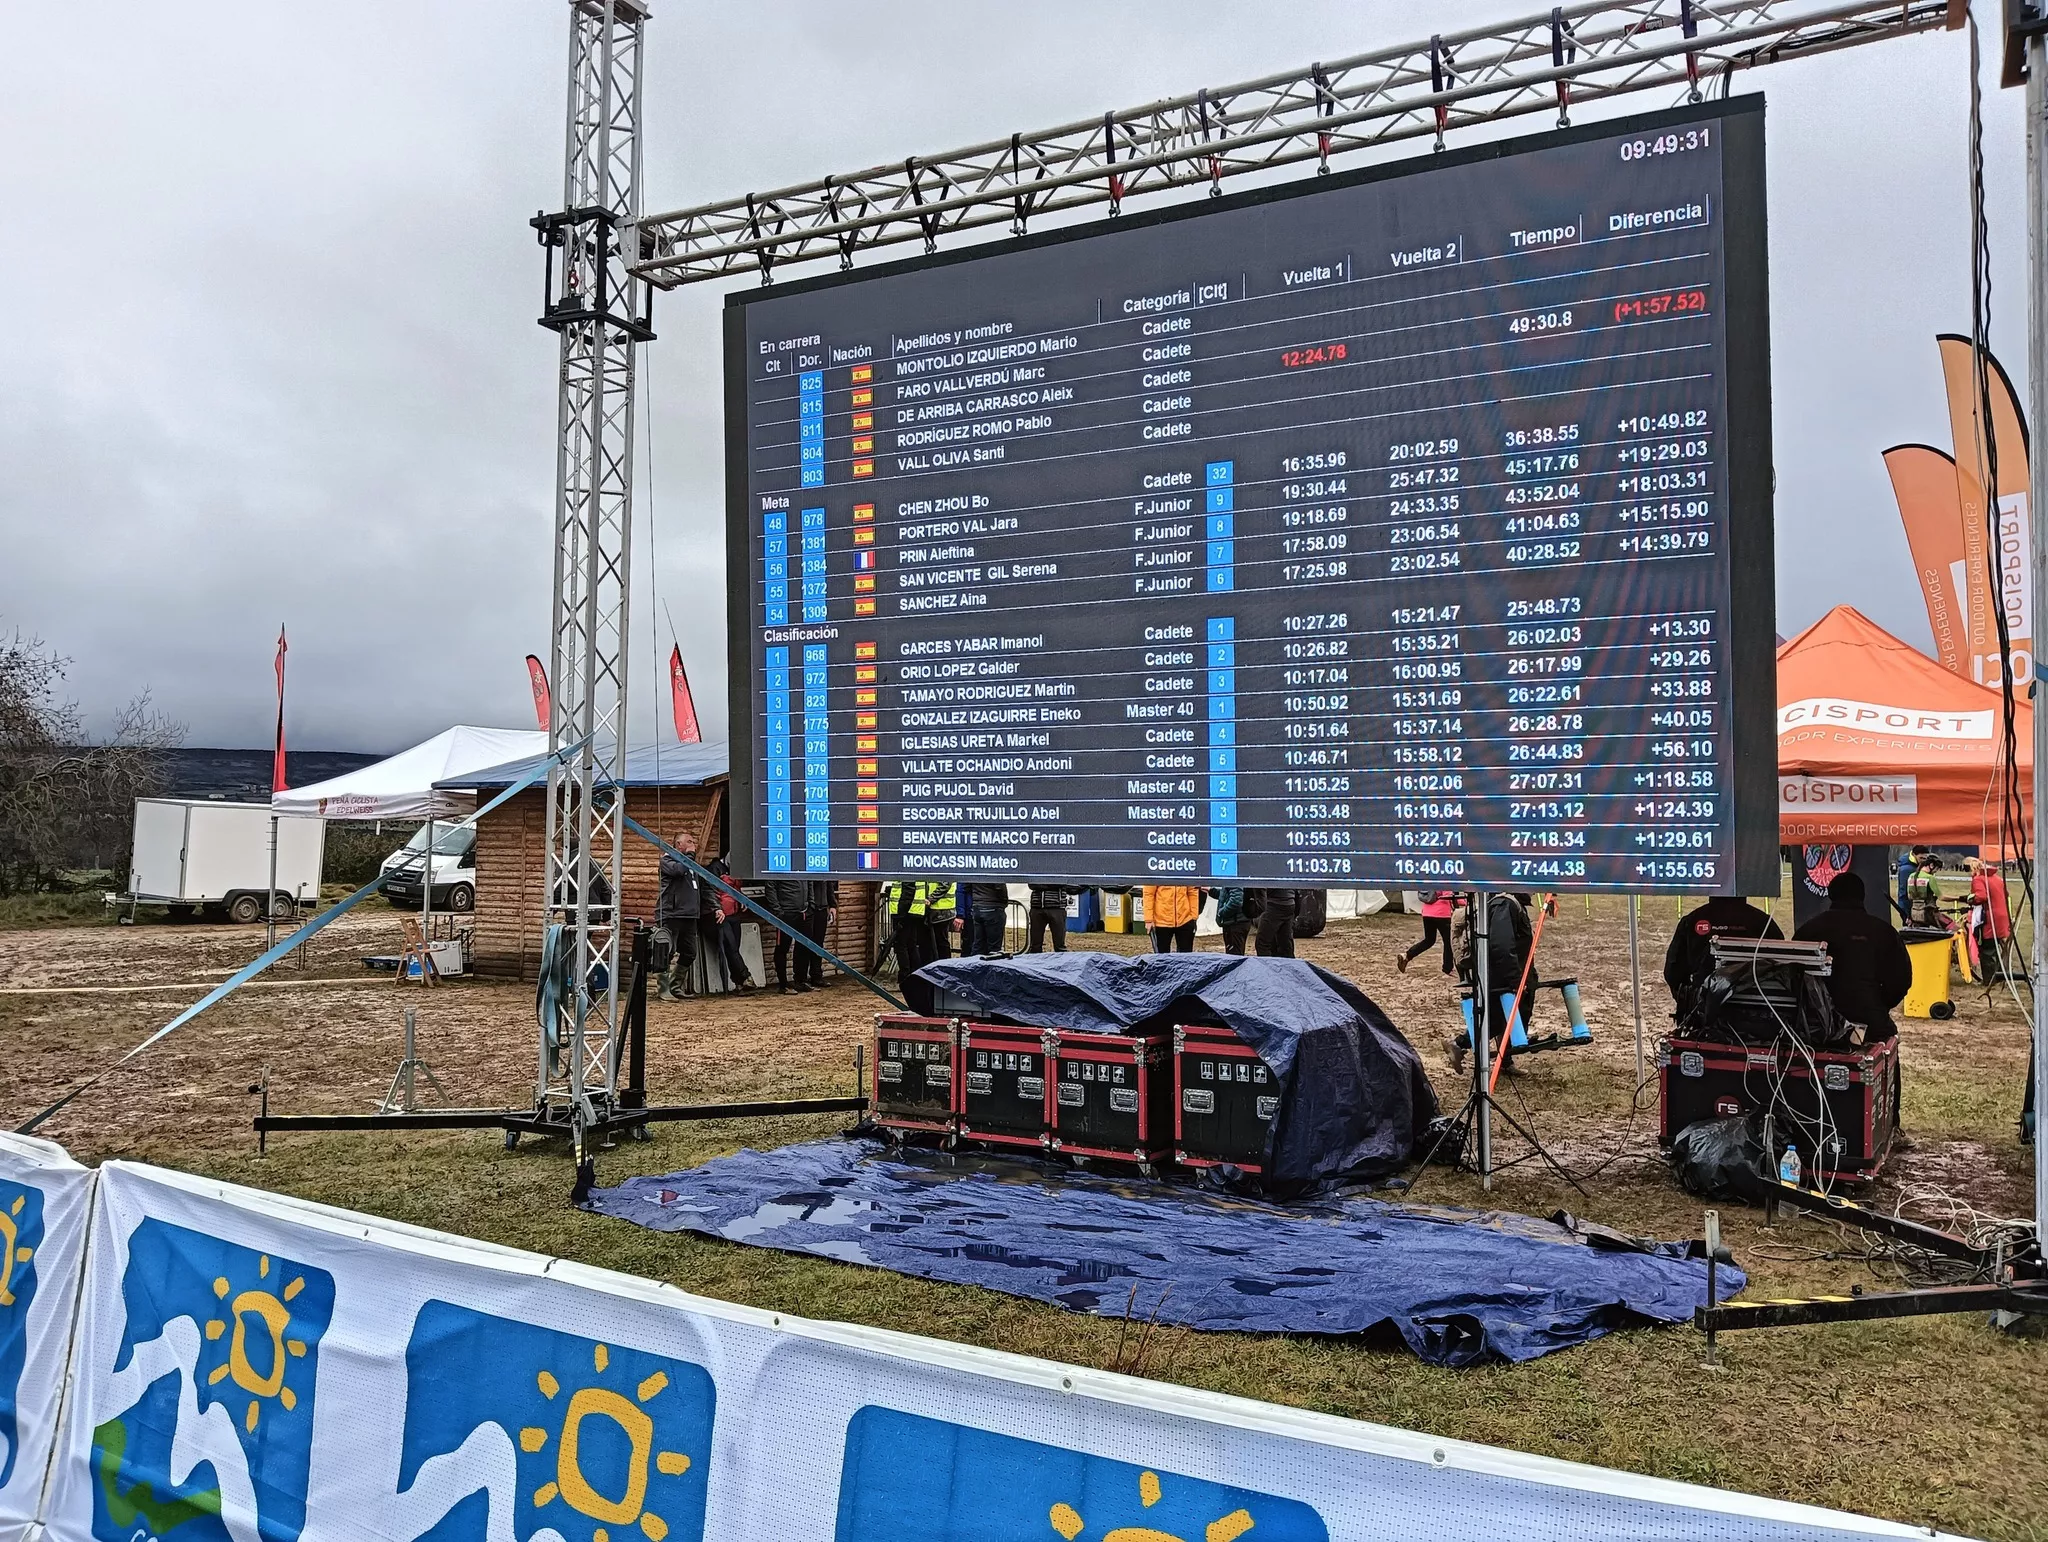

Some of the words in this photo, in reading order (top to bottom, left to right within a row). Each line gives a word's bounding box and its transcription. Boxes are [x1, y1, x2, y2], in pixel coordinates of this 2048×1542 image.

[1620, 128, 1708, 161] 09:49:31
[1609, 203, 1701, 231] Diferencia
[1510, 225, 1575, 246] Tiempo
[1390, 247, 1441, 267] Vuelta
[1446, 242, 1455, 258] 2
[1283, 266, 1330, 285] Vuelta
[1335, 262, 1342, 276] 1
[1198, 282, 1227, 304] [Clt]
[1614, 291, 1705, 321] (+1:57.52)
[1142, 317, 1191, 335] Cadete
[1509, 310, 1572, 333] 49:30.8
[760, 340, 775, 354] En
[778, 334, 820, 351] carrera
[896, 332, 951, 353] Apellidos
[953, 331, 961, 345] y
[965, 322, 1013, 340] nombre
[799, 354, 822, 367] Dor.
[833, 344, 871, 361] Nación
[897, 353, 964, 375] MONTOLIO
[967, 341, 1037, 364] IZQUIERDO
[1040, 335, 1077, 352] Mario
[1142, 343, 1191, 361] Cadete
[1282, 344, 1347, 367] 12:24.78
[765, 359, 781, 373] Clt
[801, 377, 821, 392] 825
[897, 382, 930, 399] FARO
[933, 367, 1009, 393] VALLVERDÚ
[1013, 367, 1045, 382] Marc
[1142, 369, 1191, 387] Cadete
[897, 409, 914, 423] DE
[917, 402, 963, 420] ARRIBA
[966, 391, 1038, 413] CARRASCO
[1041, 386, 1073, 402] Aleix
[1143, 395, 1191, 413] Cadete
[801, 423, 821, 438] 811
[897, 425, 970, 447] RODRÍGUEZ
[972, 419, 1012, 437] ROMO
[1015, 415, 1051, 431] Pablo
[1142, 422, 1191, 439] Cadete
[897, 455, 930, 470] VALL
[932, 450, 971, 466] OLIVA
[973, 445, 1004, 461] Santi
[1282, 451, 1346, 472] 16:35.96
[802, 469, 823, 484] 803
[1143, 471, 1192, 488] Cadete
[1212, 466, 1226, 481] 32
[1389, 467, 1458, 488] 25:47.32
[1505, 483, 1580, 504] 43:52.04
[762, 496, 789, 510] Meta
[898, 500, 932, 516] CHEN
[934, 496, 968, 512] ZHOU
[971, 495, 989, 508] Bo
[1135, 498, 1192, 515] F.Junior
[1619, 501, 1708, 522] +15:15.90
[769, 517, 782, 530] 48
[899, 522, 959, 540] PORTERO
[962, 519, 987, 533] VAL
[989, 517, 1018, 530] Jara
[1134, 523, 1193, 541] F.Junior
[801, 536, 826, 550] 1381
[899, 549, 926, 563] PRIN
[929, 546, 974, 561] Aleftina
[1135, 550, 1192, 567] F.Junior
[899, 572, 924, 587] SAN
[926, 567, 981, 584] VICENTE
[987, 565, 1009, 579] GIL
[1012, 563, 1057, 577] Serena
[1282, 561, 1347, 580] 17:25.98
[801, 582, 827, 595] 1372
[1135, 576, 1193, 592] F.Junior
[899, 594, 957, 610] SANCHEZ
[959, 593, 986, 606] Aina
[1391, 605, 1460, 623] 15:21.47
[763, 625, 838, 642] Clasificación
[1144, 624, 1193, 640] Cadete
[1507, 626, 1581, 645] 26:02.03
[900, 640, 951, 655] GARCES
[954, 637, 998, 652] YABAR
[1001, 634, 1042, 649] Imanol
[804, 649, 825, 662] 968
[1144, 651, 1193, 666] Cadete
[1650, 649, 1710, 667] +29.26
[900, 665, 931, 679] ORIO
[934, 662, 976, 677] LOPEZ
[978, 661, 1020, 674] Galder
[901, 688, 954, 702] TAMAYO
[957, 684, 1031, 700] RODRIGUEZ
[1034, 682, 1075, 696] Martin
[1145, 677, 1193, 691] Cadete
[804, 694, 825, 707] 823
[1284, 695, 1348, 711] 10:50.92
[901, 711, 967, 726] GONZALEZ
[969, 708, 1037, 723] IZAGUIRRE
[1040, 707, 1081, 721] Eneko
[1126, 703, 1174, 718] Master
[1177, 701, 1193, 715] 40
[1145, 728, 1194, 742] Cadete
[1393, 718, 1462, 735] 15:37.14
[805, 740, 826, 753] 976
[901, 735, 958, 749] IGLESIAS
[961, 734, 1004, 747] URETA
[1006, 732, 1049, 746] Markel
[1834, 733, 1993, 751] EXPERIENCES
[1509, 743, 1583, 760] 26:44.83
[901, 759, 953, 773] VILLATE
[956, 758, 1023, 772] OCHANDIO
[1026, 756, 1072, 770] Andoni
[1146, 754, 1195, 768] Cadete
[1127, 780, 1175, 794] Master
[1178, 779, 1194, 793] 40
[1634, 770, 1713, 787] +1:18.58
[804, 786, 829, 798] 1701
[902, 784, 931, 796] PUIG
[934, 783, 976, 796] PUJOL
[978, 782, 1013, 795] David
[336, 806, 374, 814] EDELWEISS
[902, 807, 963, 820] ESCOBAR
[966, 807, 1028, 820] TRUJILLO
[1031, 806, 1059, 819] Abel
[1128, 806, 1175, 819] Master
[1178, 805, 1195, 819] 40
[1285, 804, 1349, 818] 10:53.48
[903, 831, 978, 844] BENAVENTE
[981, 831, 1029, 844] MARCO
[1032, 831, 1075, 844] Ferran
[1147, 831, 1196, 844] Cadete
[1394, 831, 1461, 846] 16:22.71
[1820, 824, 1918, 837] EXPERIENCES
[773, 854, 786, 866] 10
[903, 855, 977, 868] MONCASSIN
[980, 855, 1018, 868] Mateo
[1147, 856, 1196, 871] Cadete
[1511, 860, 1585, 876] 27:44.38
